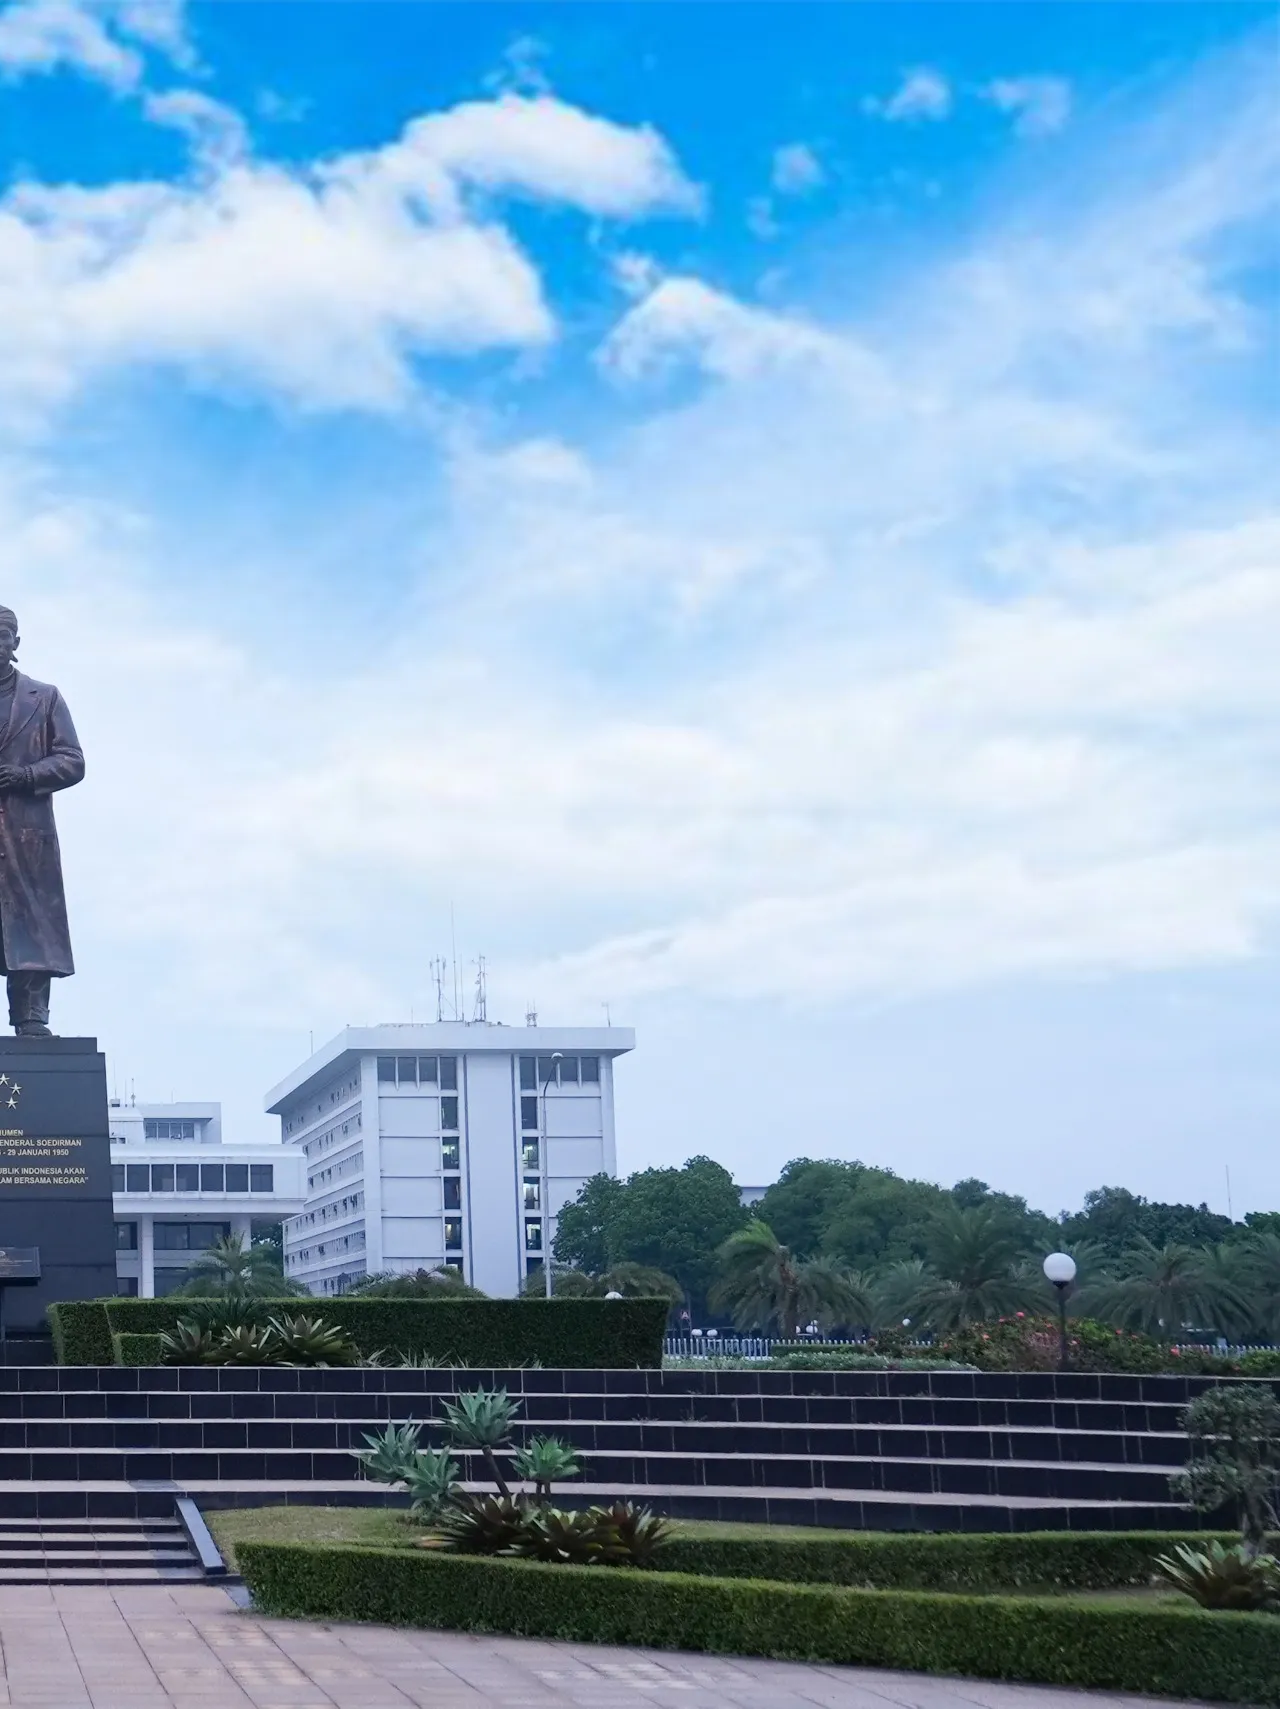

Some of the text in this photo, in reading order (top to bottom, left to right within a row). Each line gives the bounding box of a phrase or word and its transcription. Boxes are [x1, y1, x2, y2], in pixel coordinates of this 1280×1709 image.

[37, 1139, 82, 1147] SOEDIRMAN
[7, 1148, 16, 1156] 29
[17, 1148, 51, 1156] JANUARI
[52, 1148, 69, 1156] 1950
[21, 1167, 63, 1175] INDONESIA
[63, 1167, 86, 1175] AKAN
[14, 1176, 52, 1184] BERSAMA
